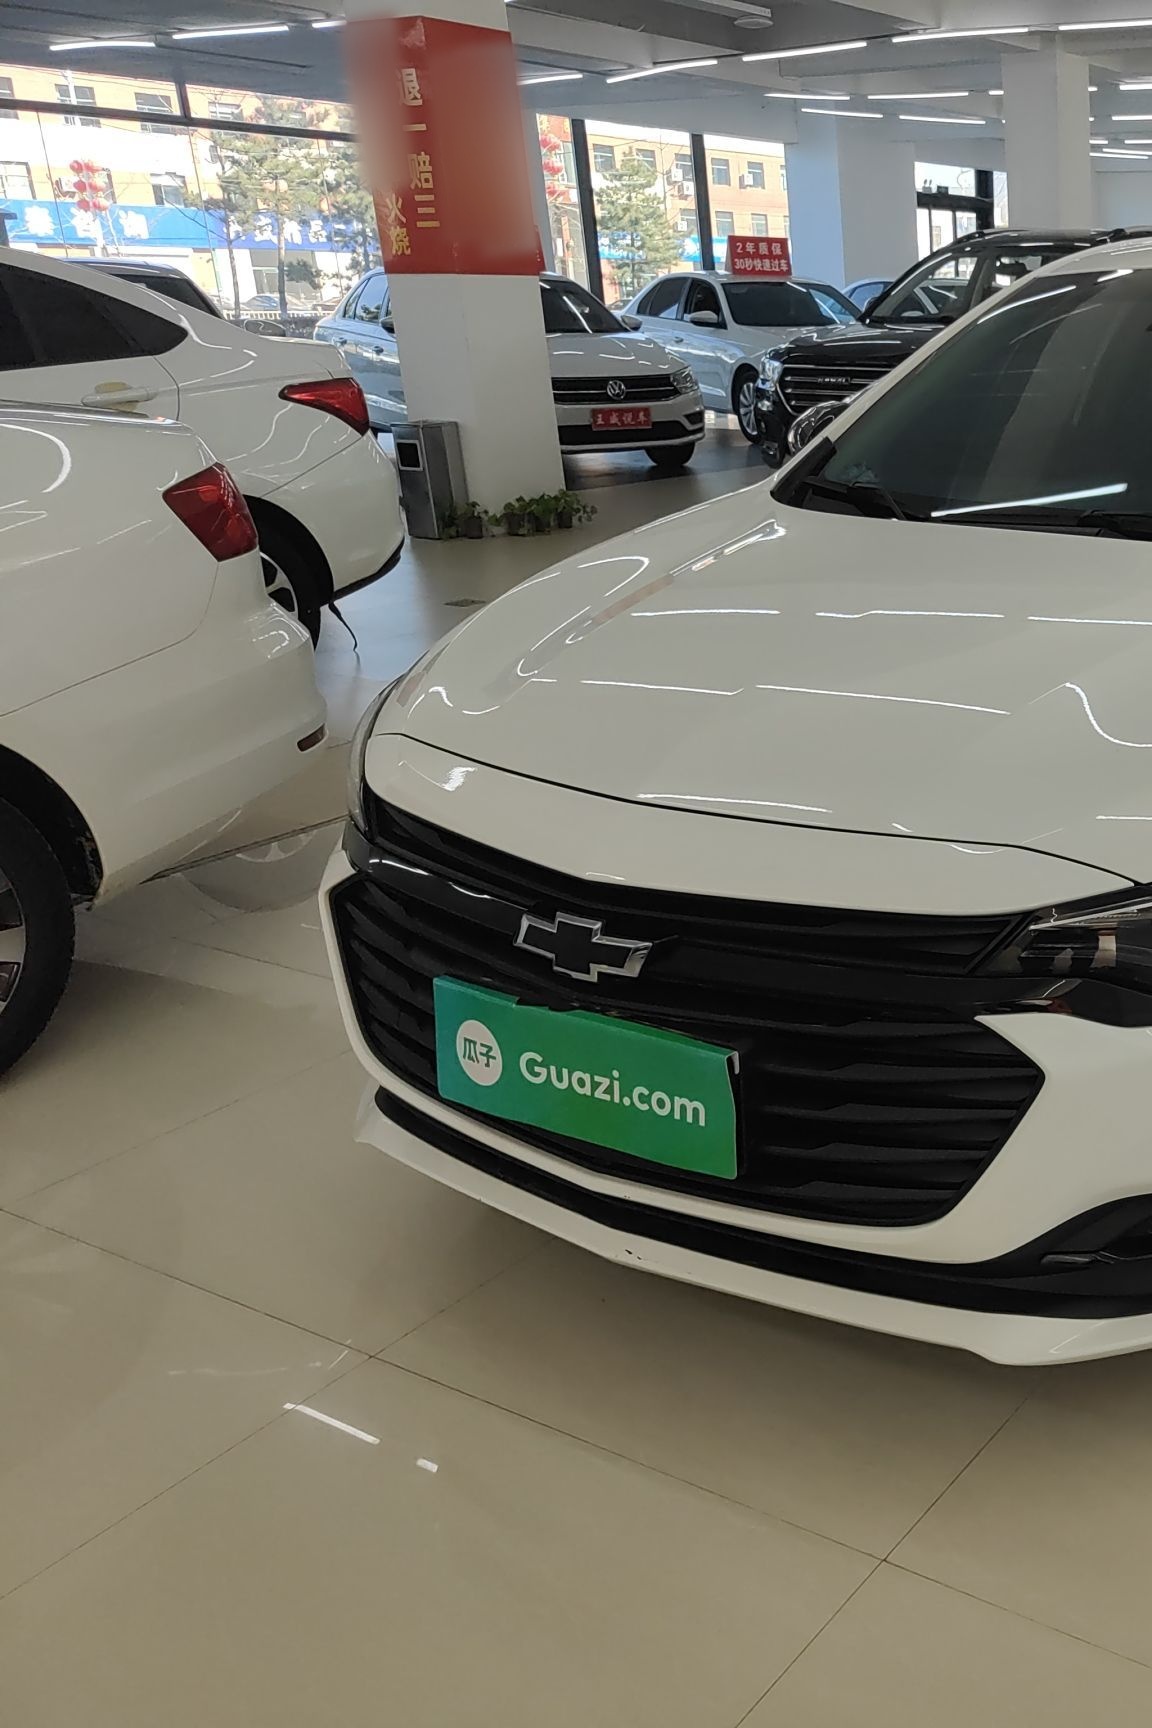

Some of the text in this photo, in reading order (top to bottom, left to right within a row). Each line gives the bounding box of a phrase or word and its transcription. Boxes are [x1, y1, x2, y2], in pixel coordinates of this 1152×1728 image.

[736, 242, 782, 255] 2年质保
[734, 257, 789, 272] 30秒快速过车
[462, 1036, 497, 1069] 瓜子
[519, 1051, 706, 1127] Guazi.com
